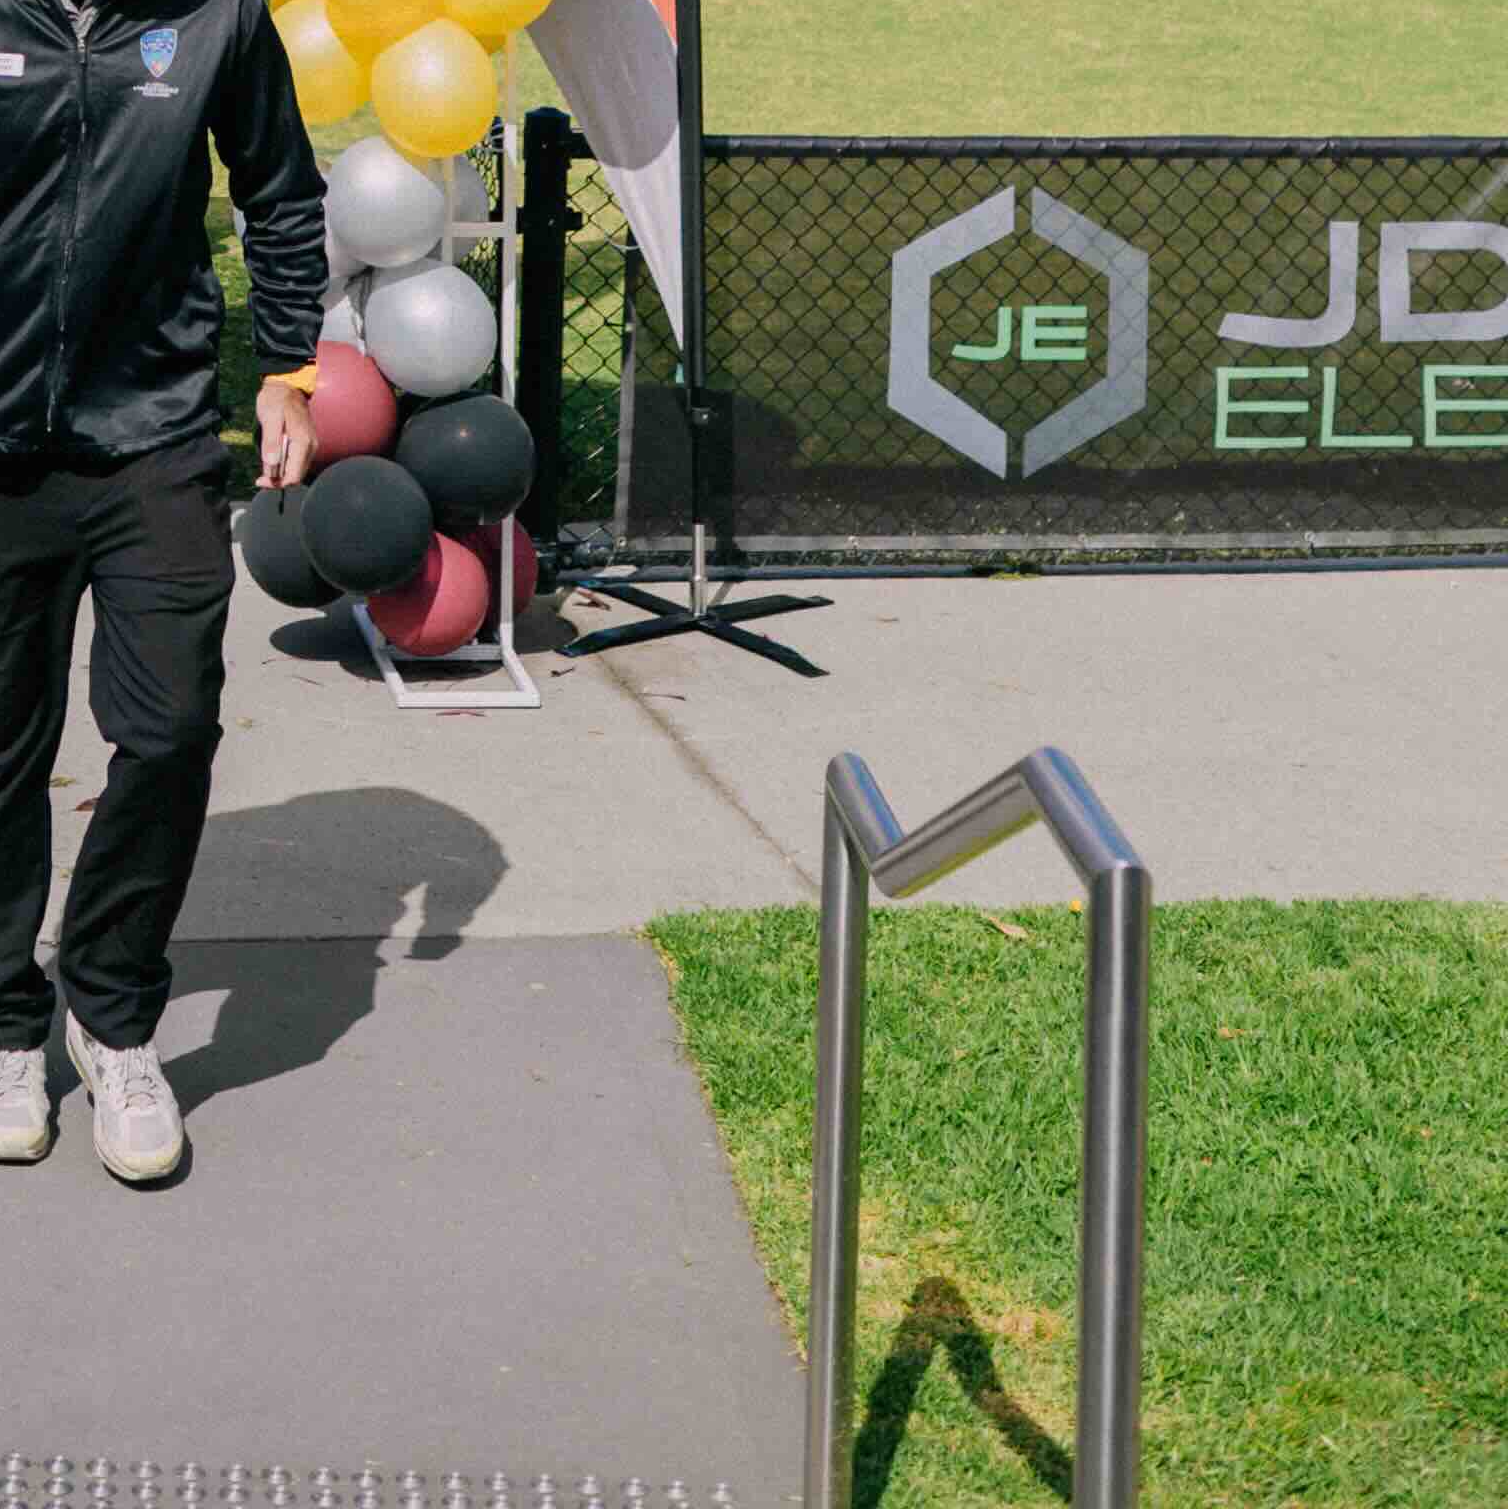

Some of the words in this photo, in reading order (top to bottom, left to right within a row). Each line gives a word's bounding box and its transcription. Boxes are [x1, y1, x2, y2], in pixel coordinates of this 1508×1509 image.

[1217, 220, 1508, 348] JD
[951, 305, 1088, 361] JE
[1214, 365, 1508, 450] ELE
